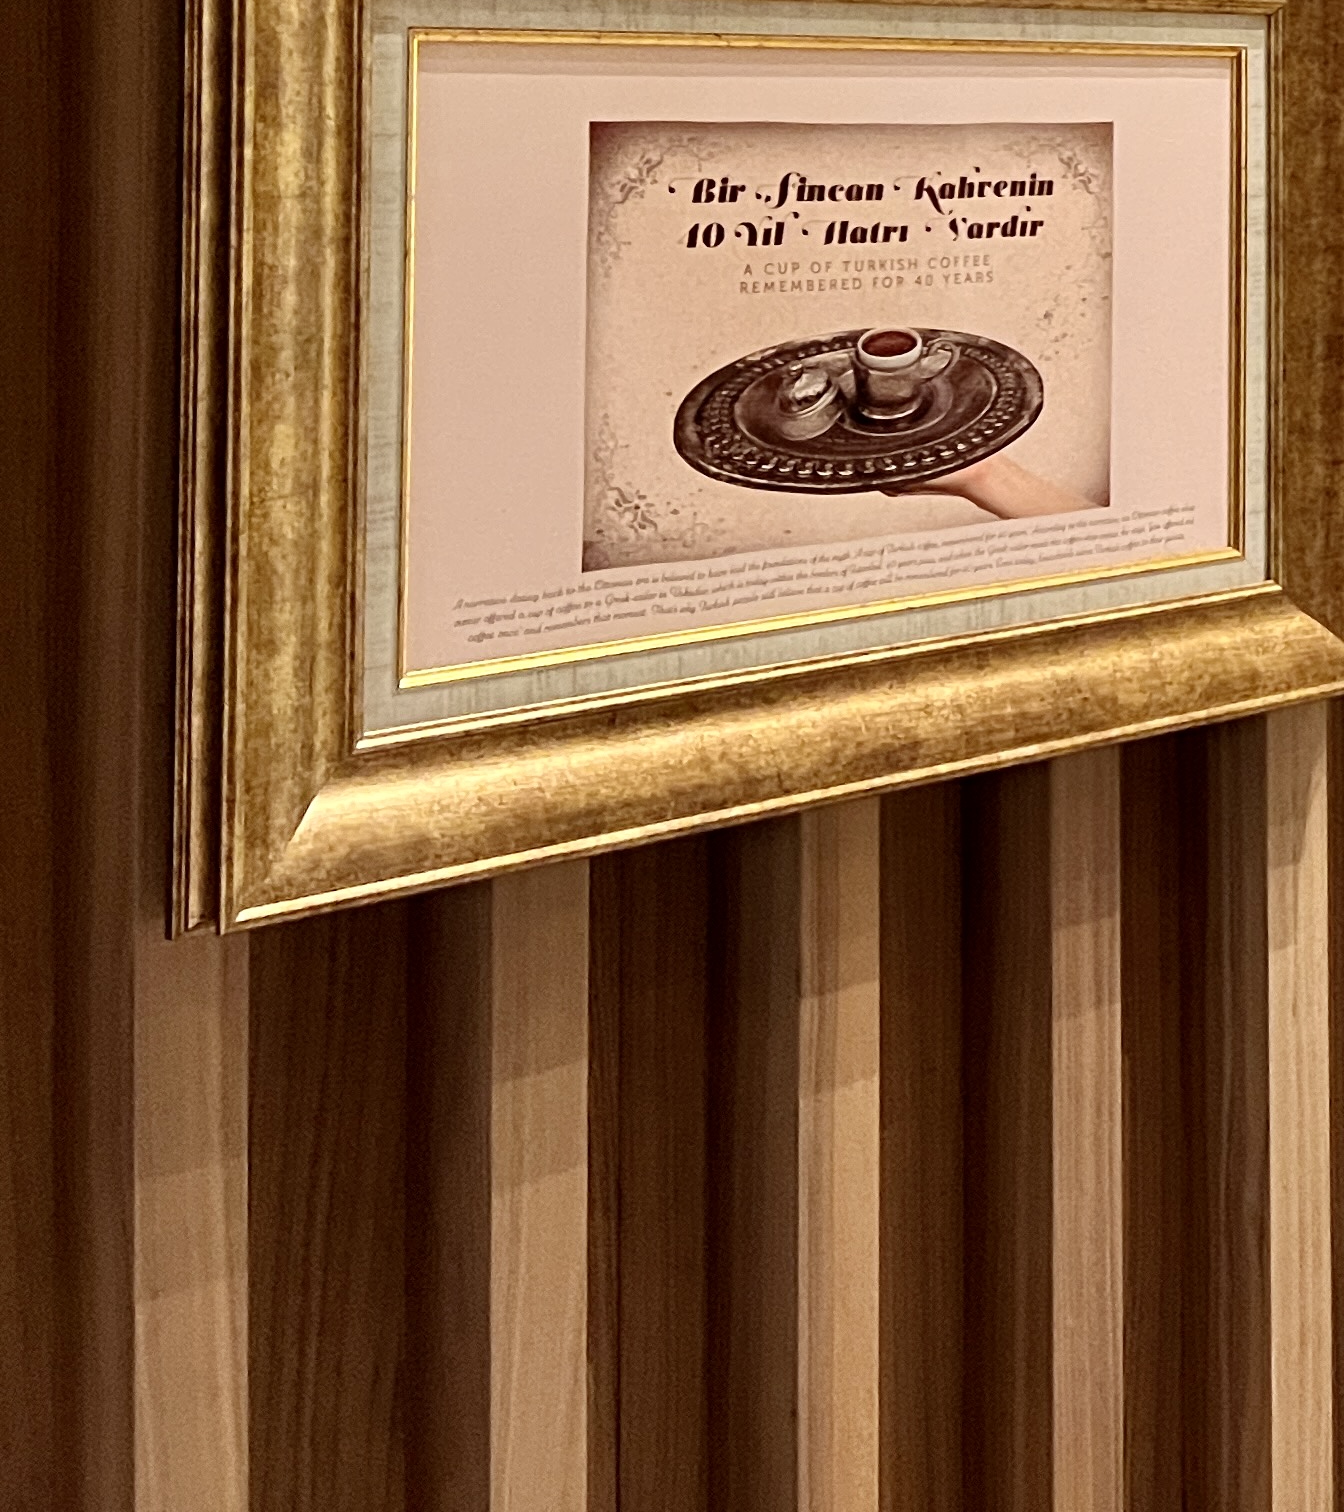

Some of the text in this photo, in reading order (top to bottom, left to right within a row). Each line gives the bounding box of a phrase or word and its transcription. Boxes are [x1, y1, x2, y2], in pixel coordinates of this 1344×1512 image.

[669, 177, 746, 203] Bir
[743, 254, 991, 276] A CUP OF TURKISH COFFEE
[740, 270, 994, 294] REMEMBERED FOR 40 YEARS
